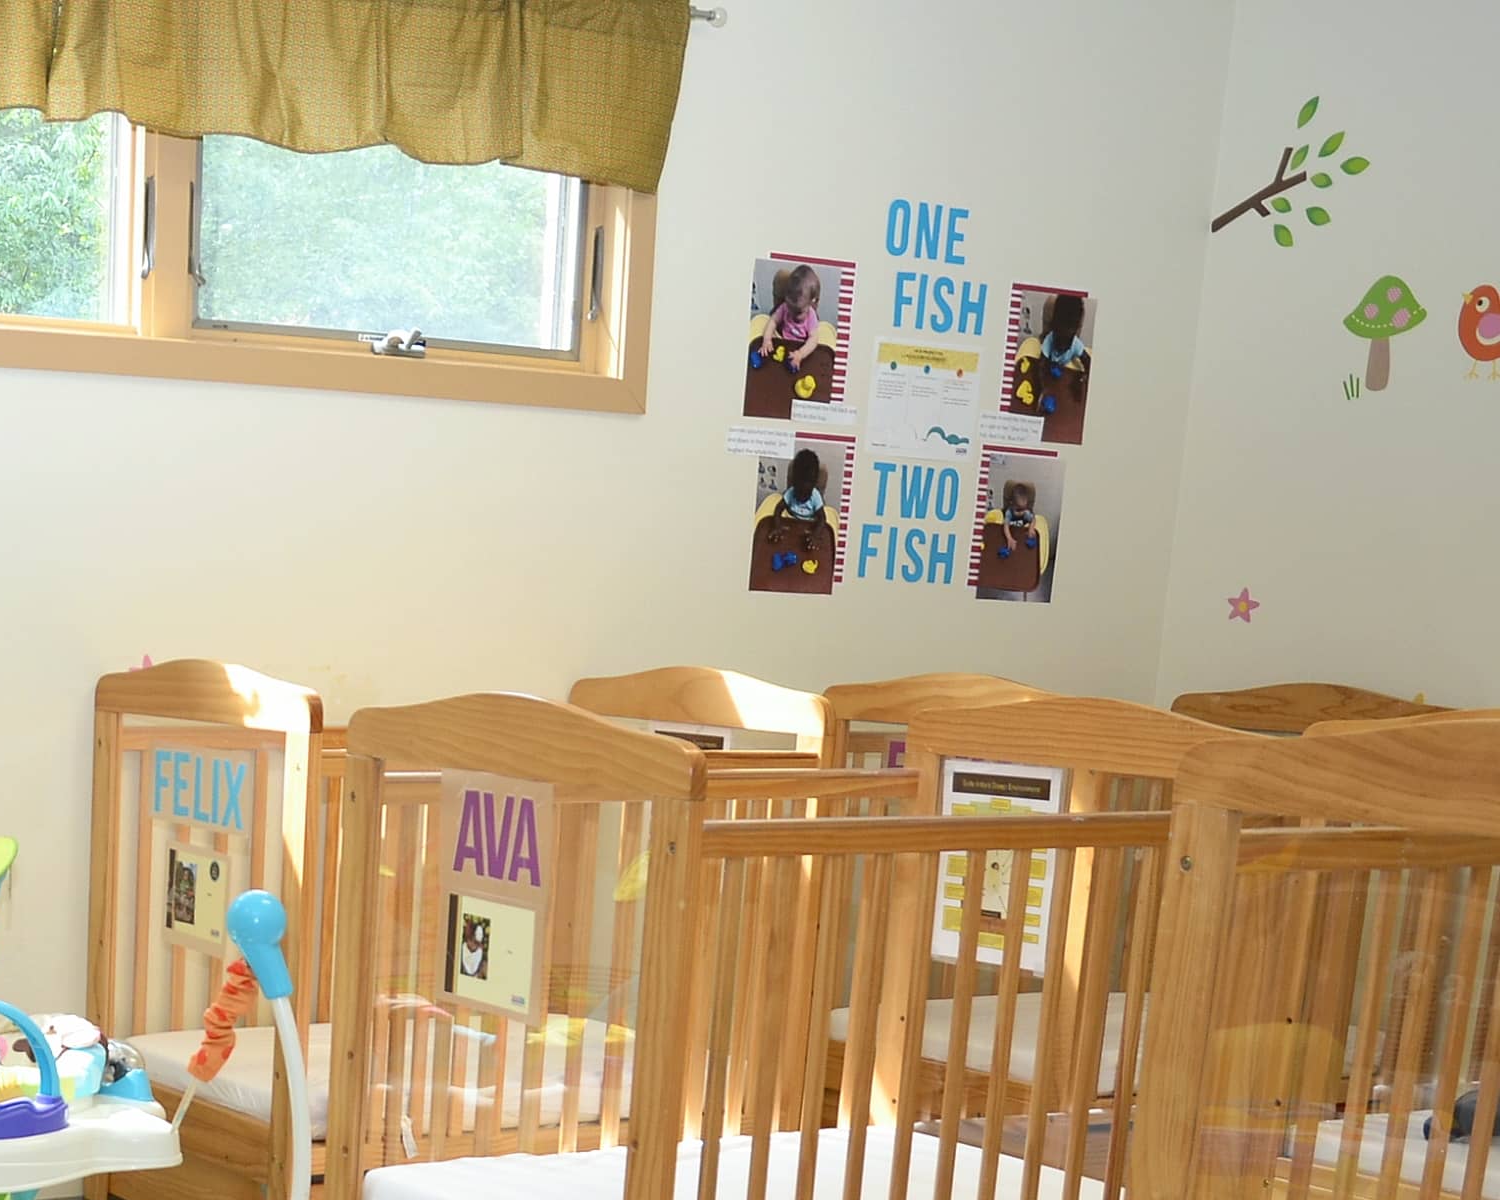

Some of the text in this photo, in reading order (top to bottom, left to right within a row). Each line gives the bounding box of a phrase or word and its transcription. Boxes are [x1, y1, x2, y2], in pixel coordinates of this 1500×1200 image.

[885, 199, 969, 265] ONE
[892, 271, 988, 336] FISH
[873, 462, 960, 522] TWO
[857, 524, 956, 584] FISH
[153, 750, 247, 830] FELIX
[453, 789, 541, 887] AVA
